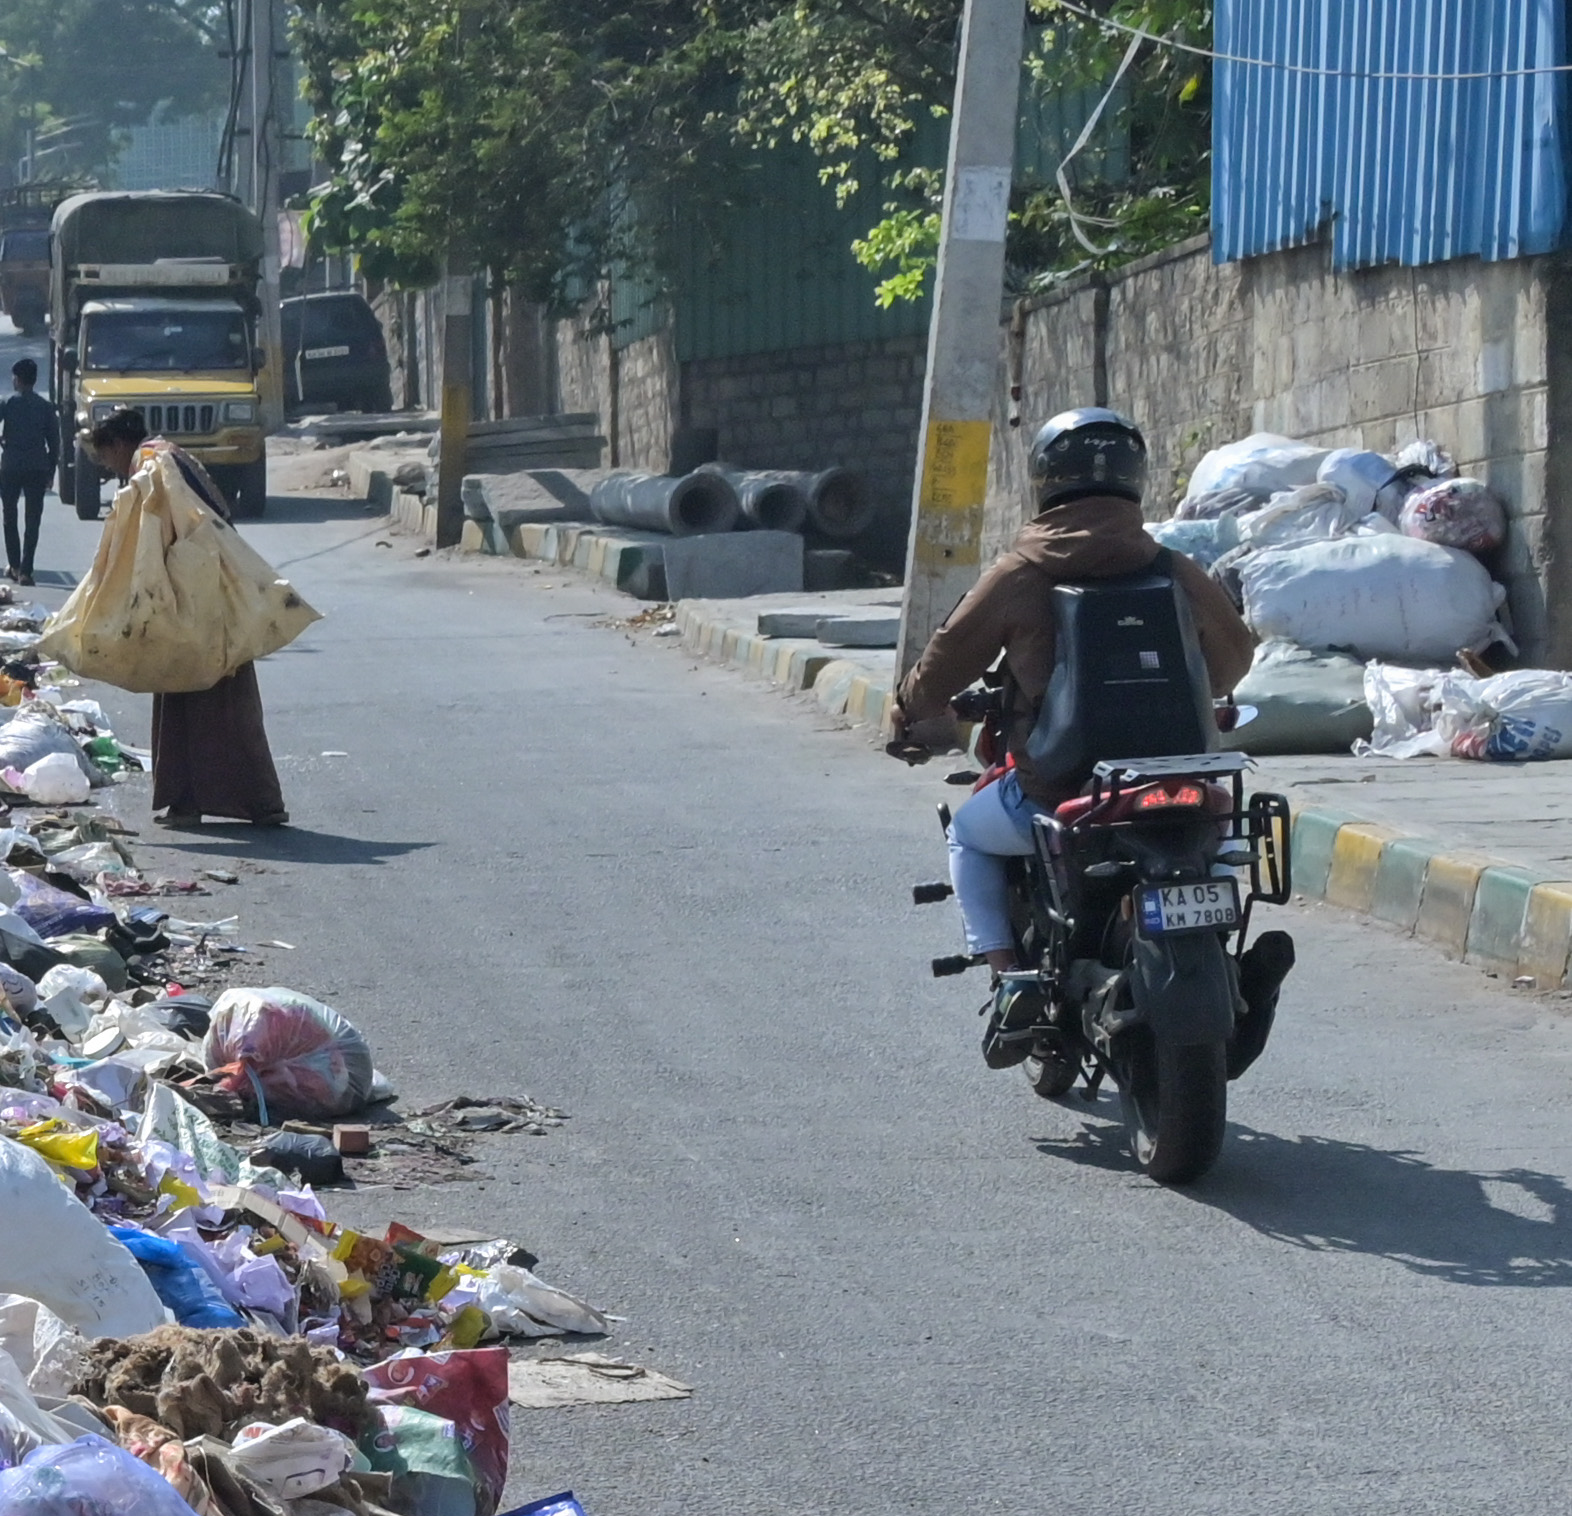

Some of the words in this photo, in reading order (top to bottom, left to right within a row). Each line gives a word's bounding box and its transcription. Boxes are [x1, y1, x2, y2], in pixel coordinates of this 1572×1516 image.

[1161, 888, 1187, 907] KA
[1193, 885, 1219, 903] 05
[1166, 912, 1186, 927] KM
[1193, 908, 1234, 925] 7808
